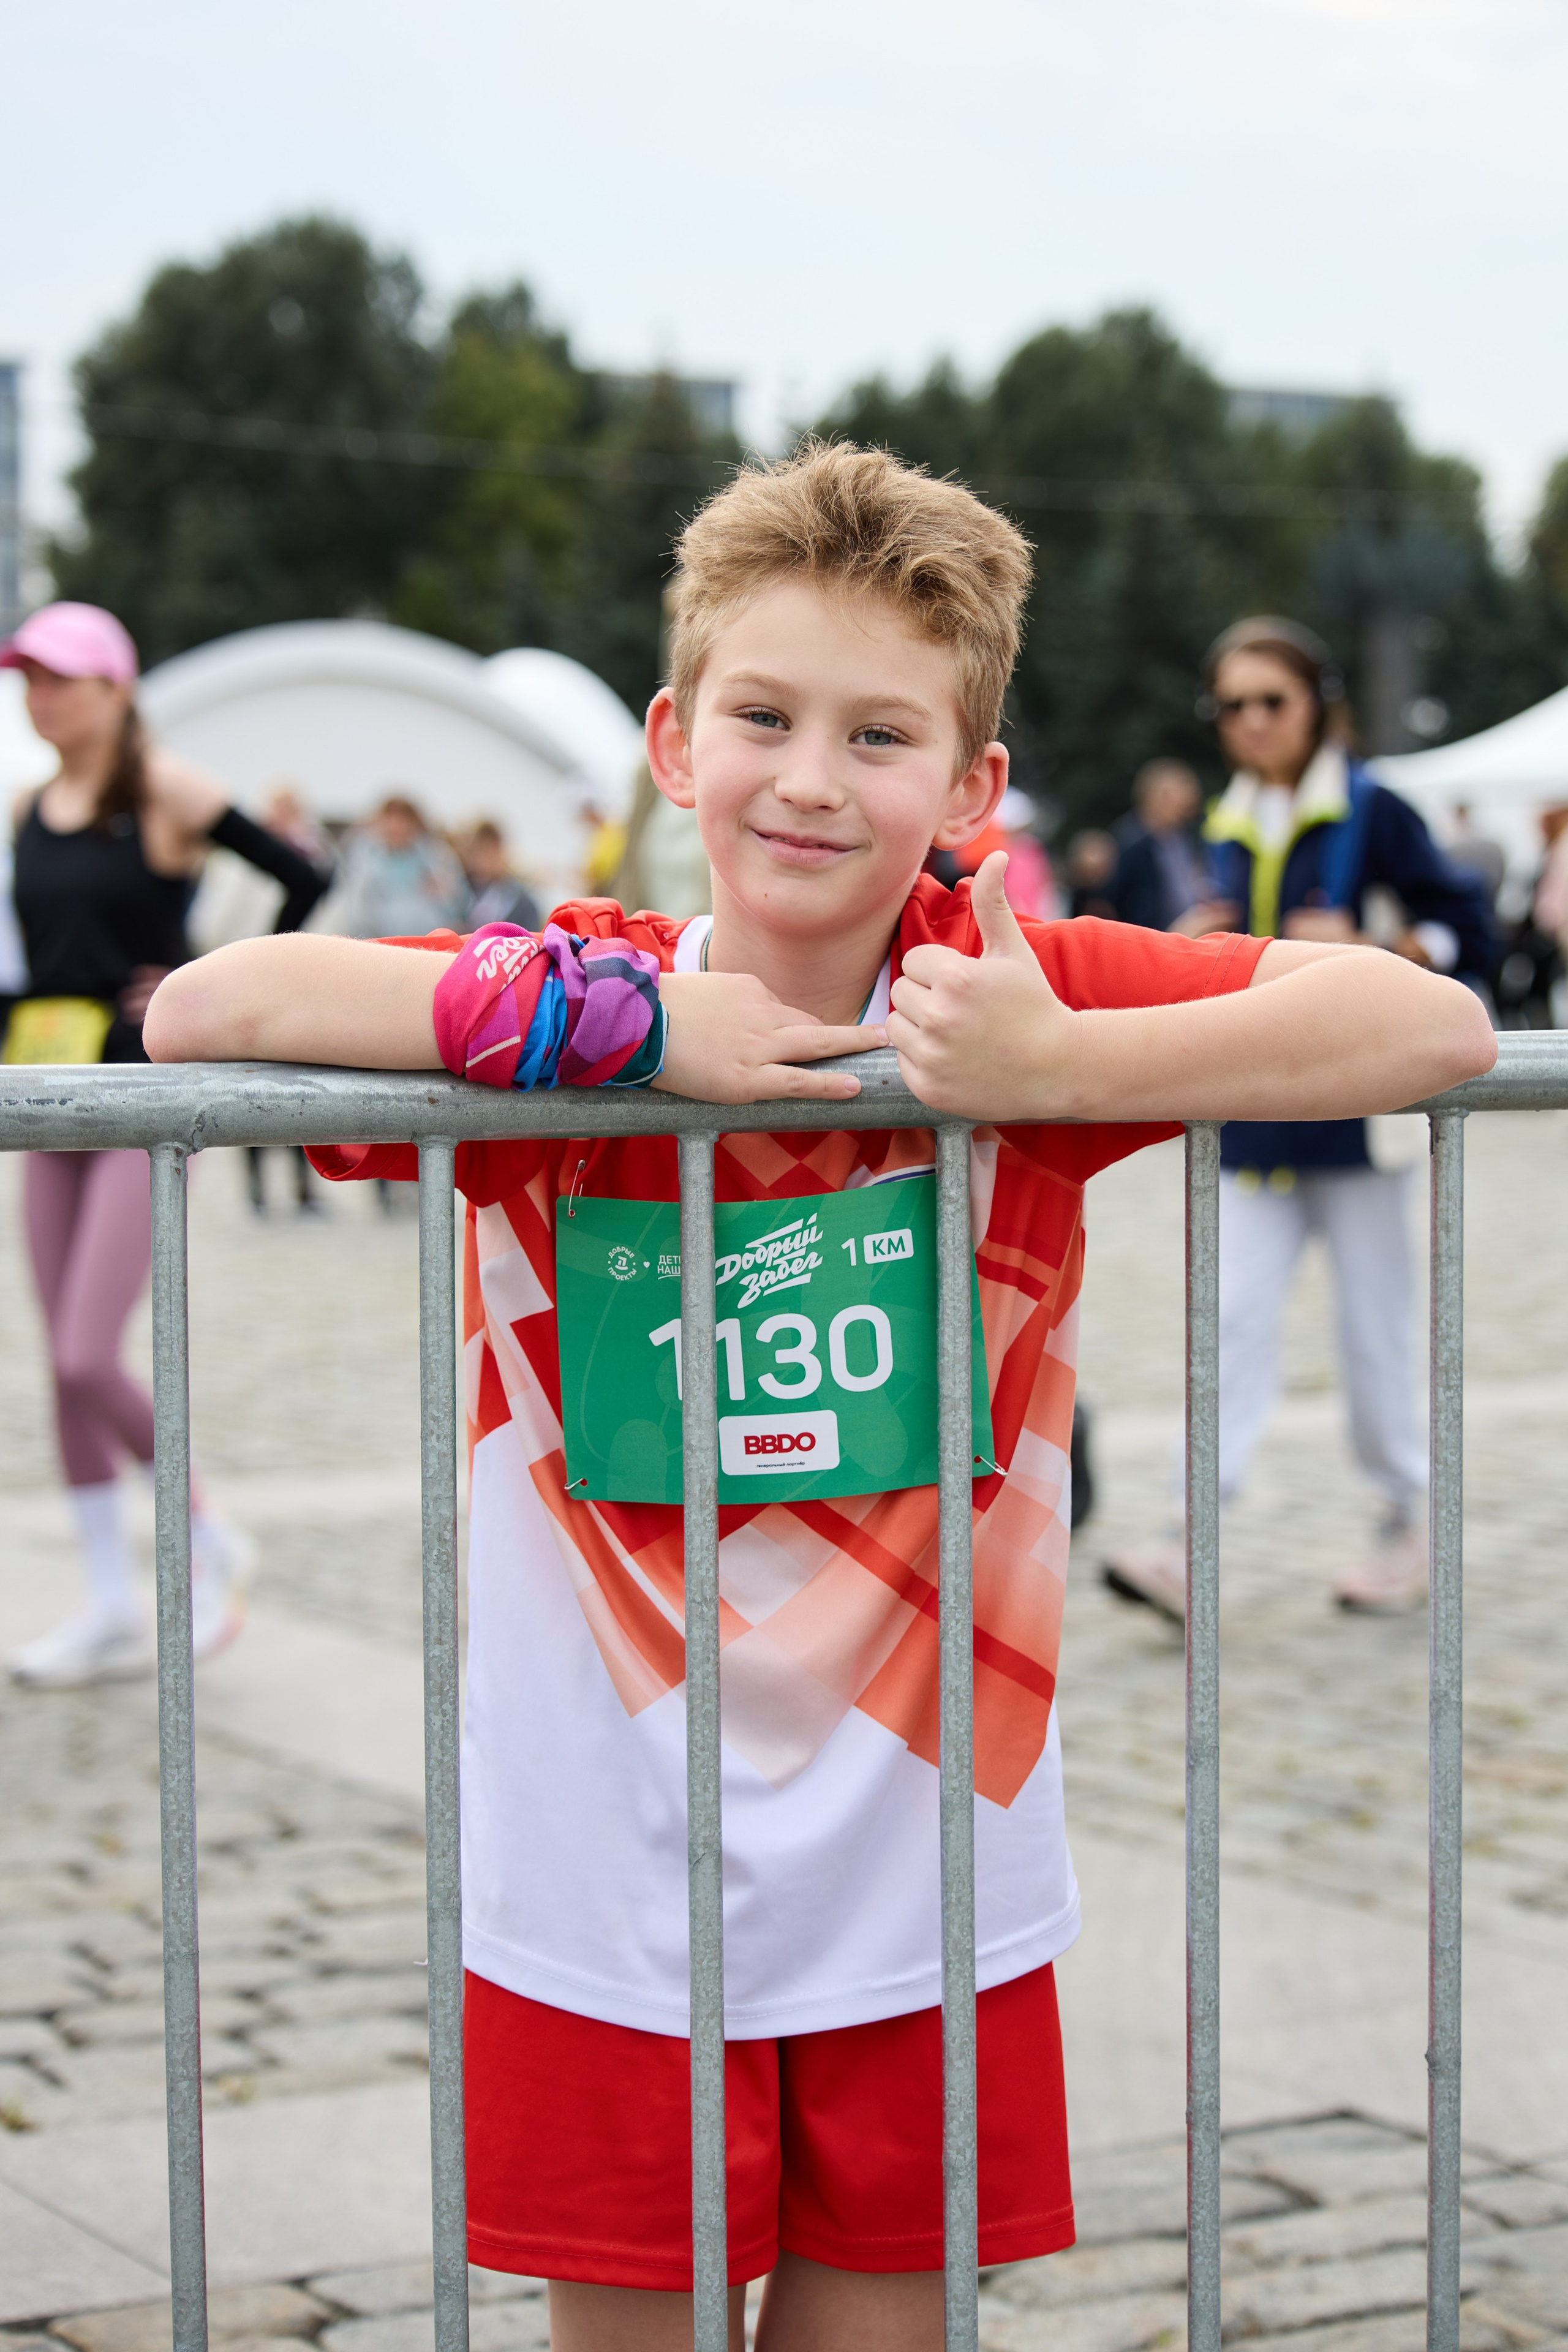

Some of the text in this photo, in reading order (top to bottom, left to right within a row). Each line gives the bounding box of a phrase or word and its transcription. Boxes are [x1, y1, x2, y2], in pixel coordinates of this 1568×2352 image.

[608, 1246, 635, 1259] ДОБРЫЕ
[658, 1255, 681, 1265] ДЕТ
[715, 1212, 824, 1286] Добрый
[841, 1235, 906, 1266] 1 КМ
[608, 1267, 637, 1281] ПРОЕКТЫ
[657, 1265, 681, 1275] НАШ
[737, 1246, 824, 1309] забег
[649, 1305, 894, 1401] 1130
[744, 1432, 816, 1455] BBDO
